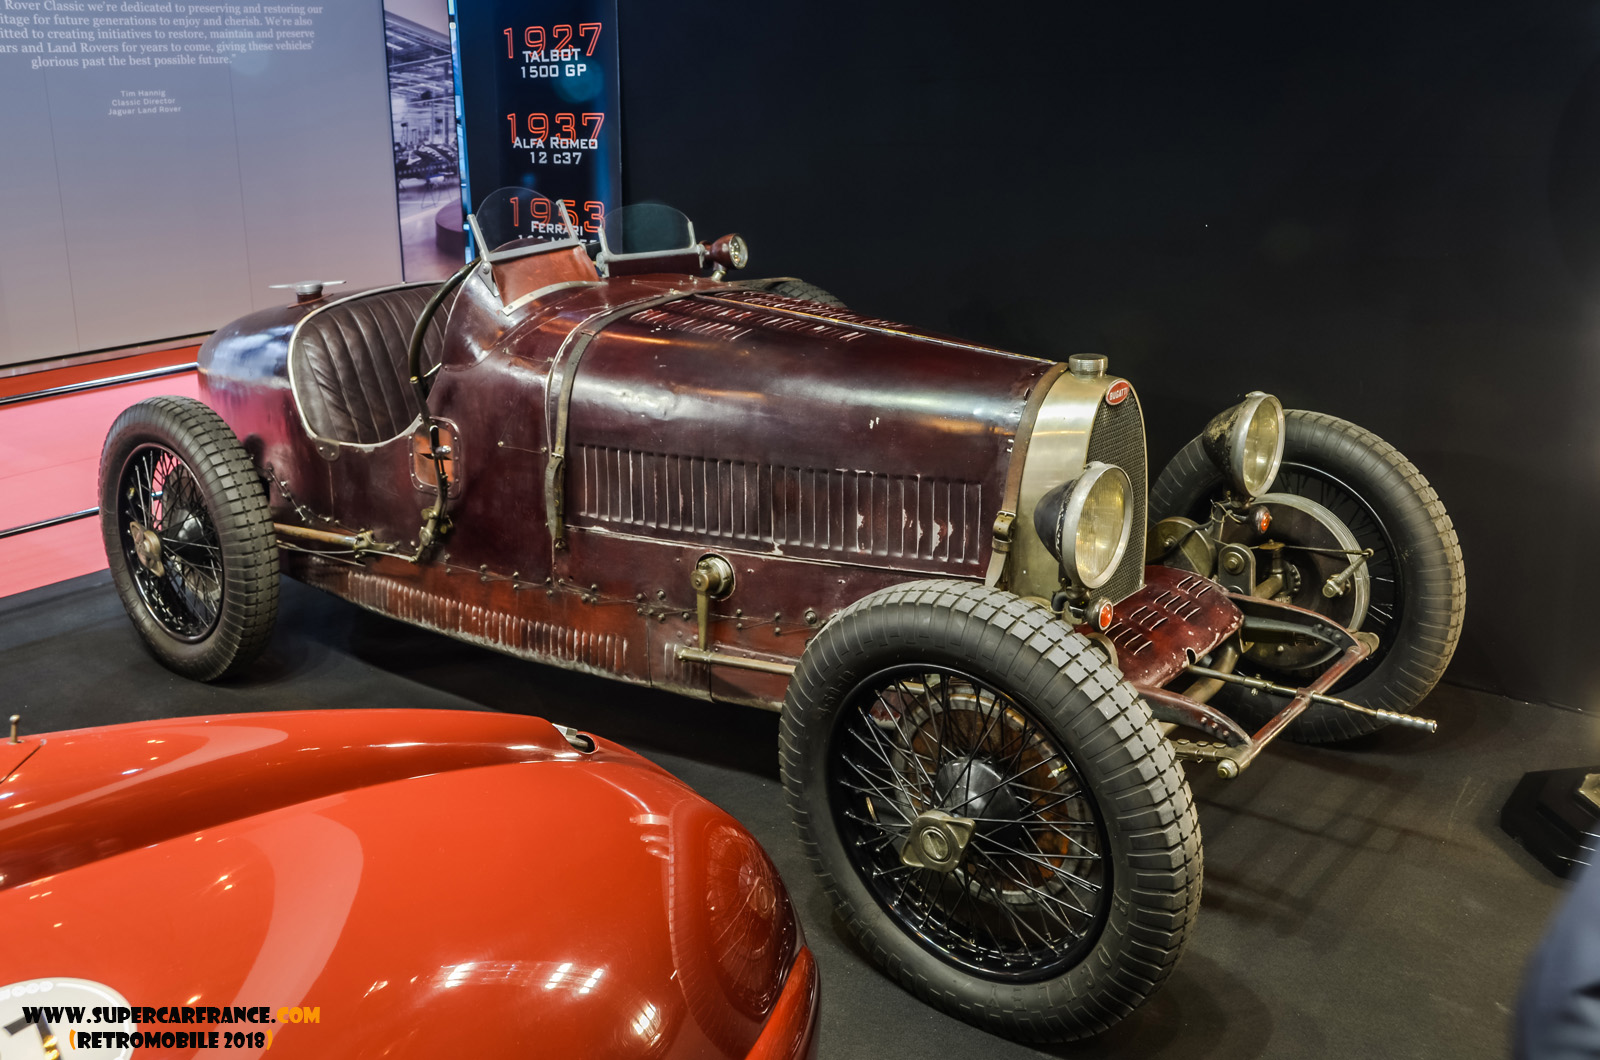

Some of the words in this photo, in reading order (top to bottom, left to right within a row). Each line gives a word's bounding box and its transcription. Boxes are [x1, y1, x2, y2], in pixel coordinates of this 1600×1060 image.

[5, 0, 40, 10] Rover
[44, 0, 84, 11] Classic
[88, 1, 117, 11] we're
[121, 2, 172, 12] dedicated
[175, 4, 185, 12] to
[188, 4, 241, 15] preserving
[243, 4, 261, 13] and
[264, 4, 306, 15] restoring
[34, 14, 50, 24] for
[54, 14, 89, 25] future
[93, 16, 157, 27] generations
[160, 17, 170, 25] to
[173, 16, 200, 28] enjoy
[204, 16, 221, 25] and
[225, 16, 262, 25] cherish.
[265, 16, 292, 25] We're
[295, 16, 312, 25] also
[32, 30, 44, 38] to
[48, 29, 95, 41] creating
[98, 29, 152, 38] initiatives
[155, 30, 165, 38] to
[169, 30, 207, 40] restore,
[210, 29, 253, 38] maintain
[256, 29, 273, 38] and
[277, 29, 315, 40] preserve
[504, 23, 602, 59] 1927
[22, 42, 43, 52] and
[48, 42, 76, 52] Land
[81, 43, 118, 52] Rovers
[122, 42, 137, 52] for
[140, 45, 168, 54] years
[171, 43, 181, 51] to
[184, 44, 213, 53] come,
[217, 42, 246, 53] giving
[249, 41, 273, 51] these
[31, 56, 79, 69] glorious
[82, 57, 105, 68] past
[109, 56, 126, 65] the
[129, 55, 151, 65] best
[154, 54, 196, 66] possible
[522, 48, 581, 63] TALBOT
[520, 64, 559, 79] 1500
[565, 63, 587, 77] GP
[138, 90, 166, 98] Hannig
[108, 108, 135, 116] Jaguar
[507, 113, 605, 145] 1937
[513, 136, 545, 149] ALFA
[550, 136, 598, 149] ROMEO
[530, 152, 547, 164] 12
[510, 196, 606, 233] 1953
[531, 220, 584, 237] FERRARI
[1109, 387, 1128, 400] BUGATTI
